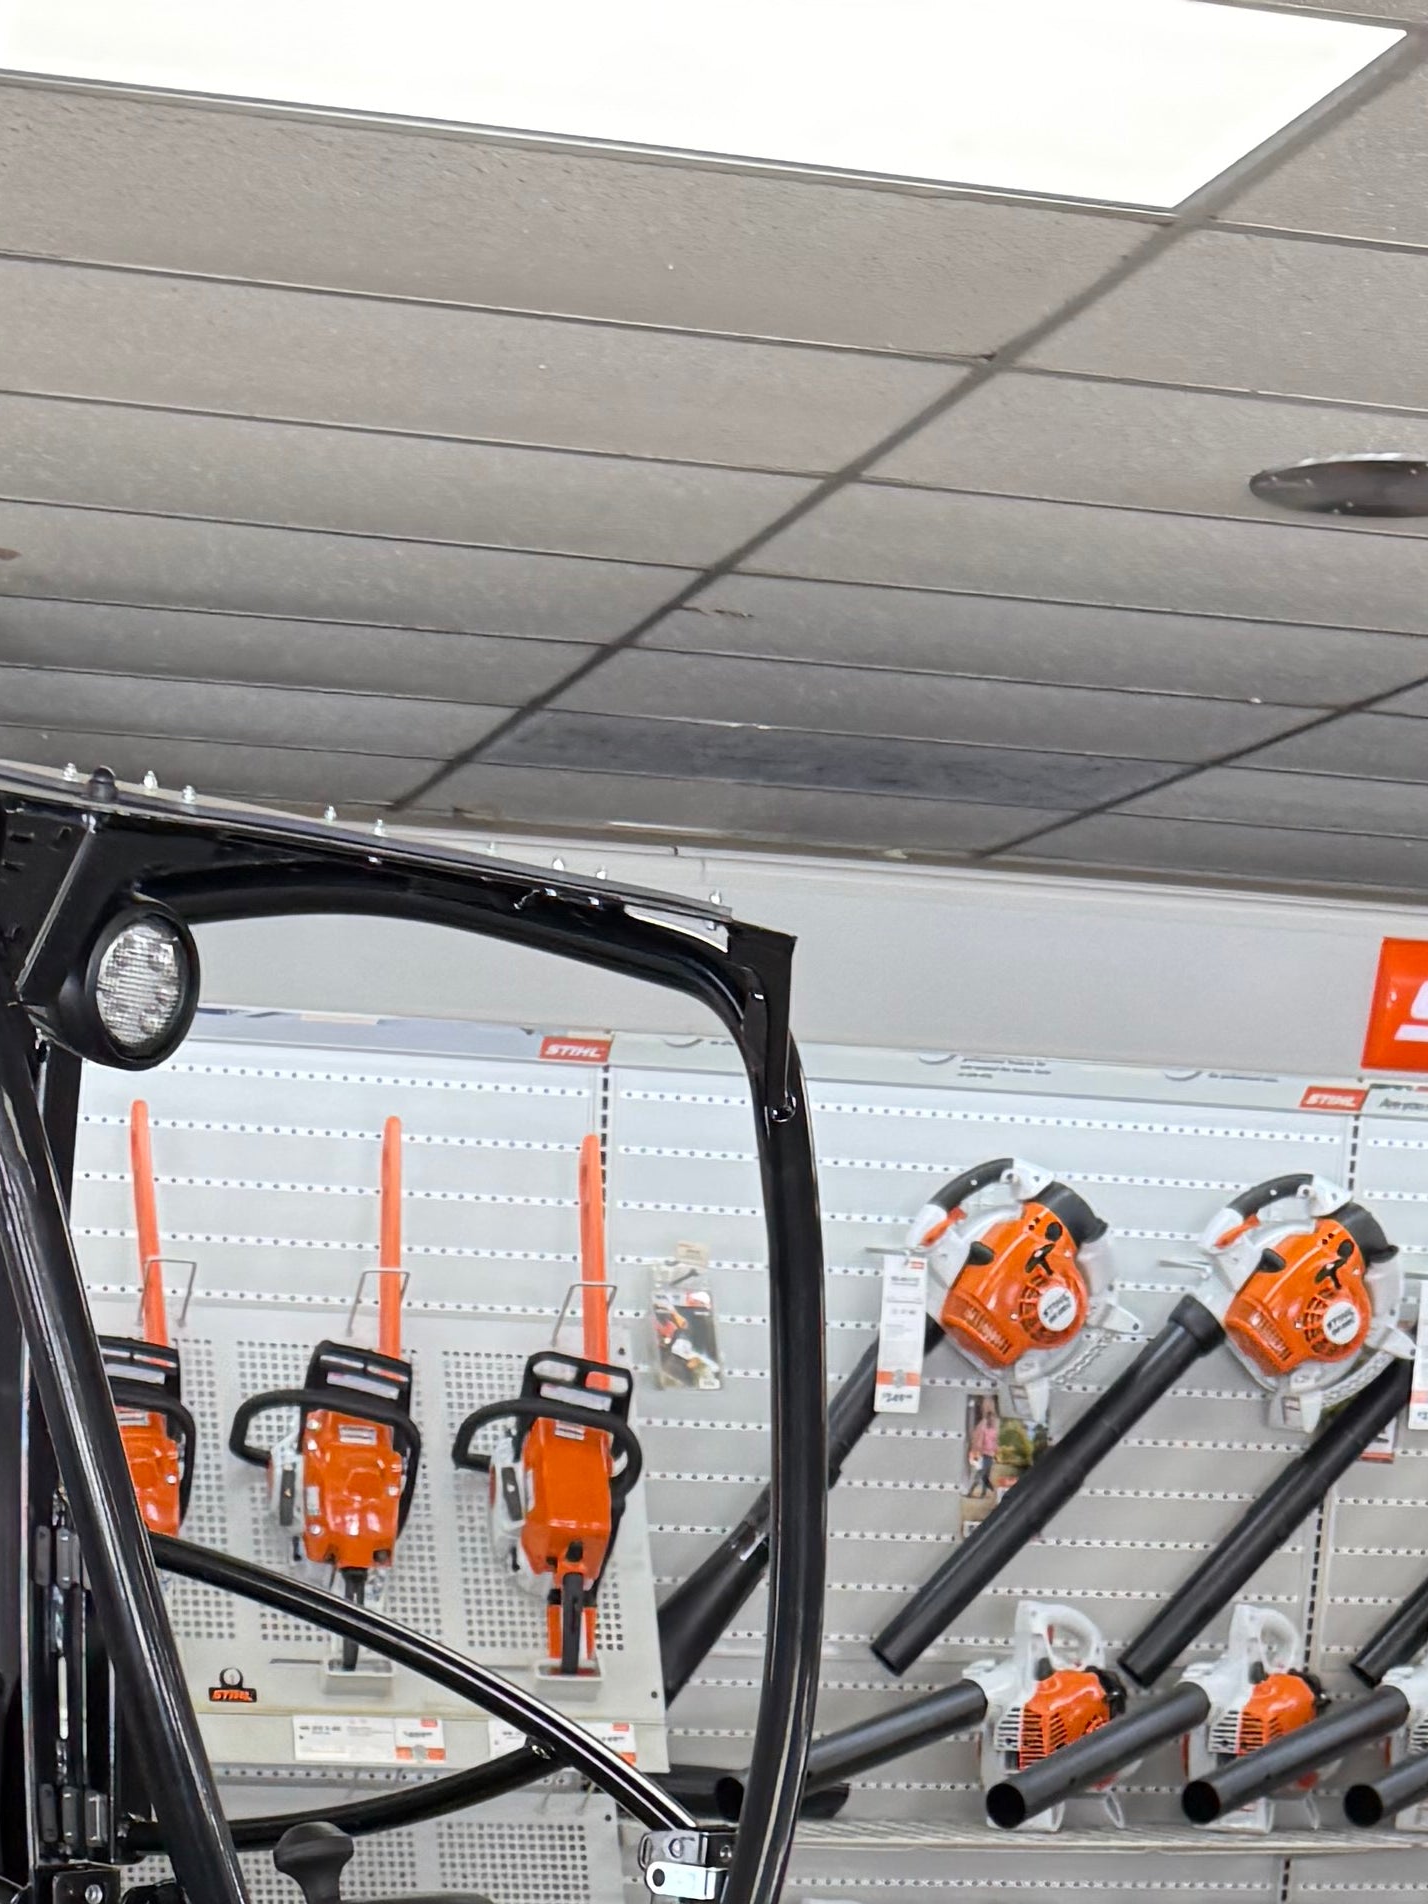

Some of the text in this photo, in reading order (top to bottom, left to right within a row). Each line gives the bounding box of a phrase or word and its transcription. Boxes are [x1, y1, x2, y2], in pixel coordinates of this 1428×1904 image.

[546, 1044, 602, 1059] STIHL
[1306, 1094, 1356, 1107] STIHL
[212, 1690, 254, 1702] STIHL
